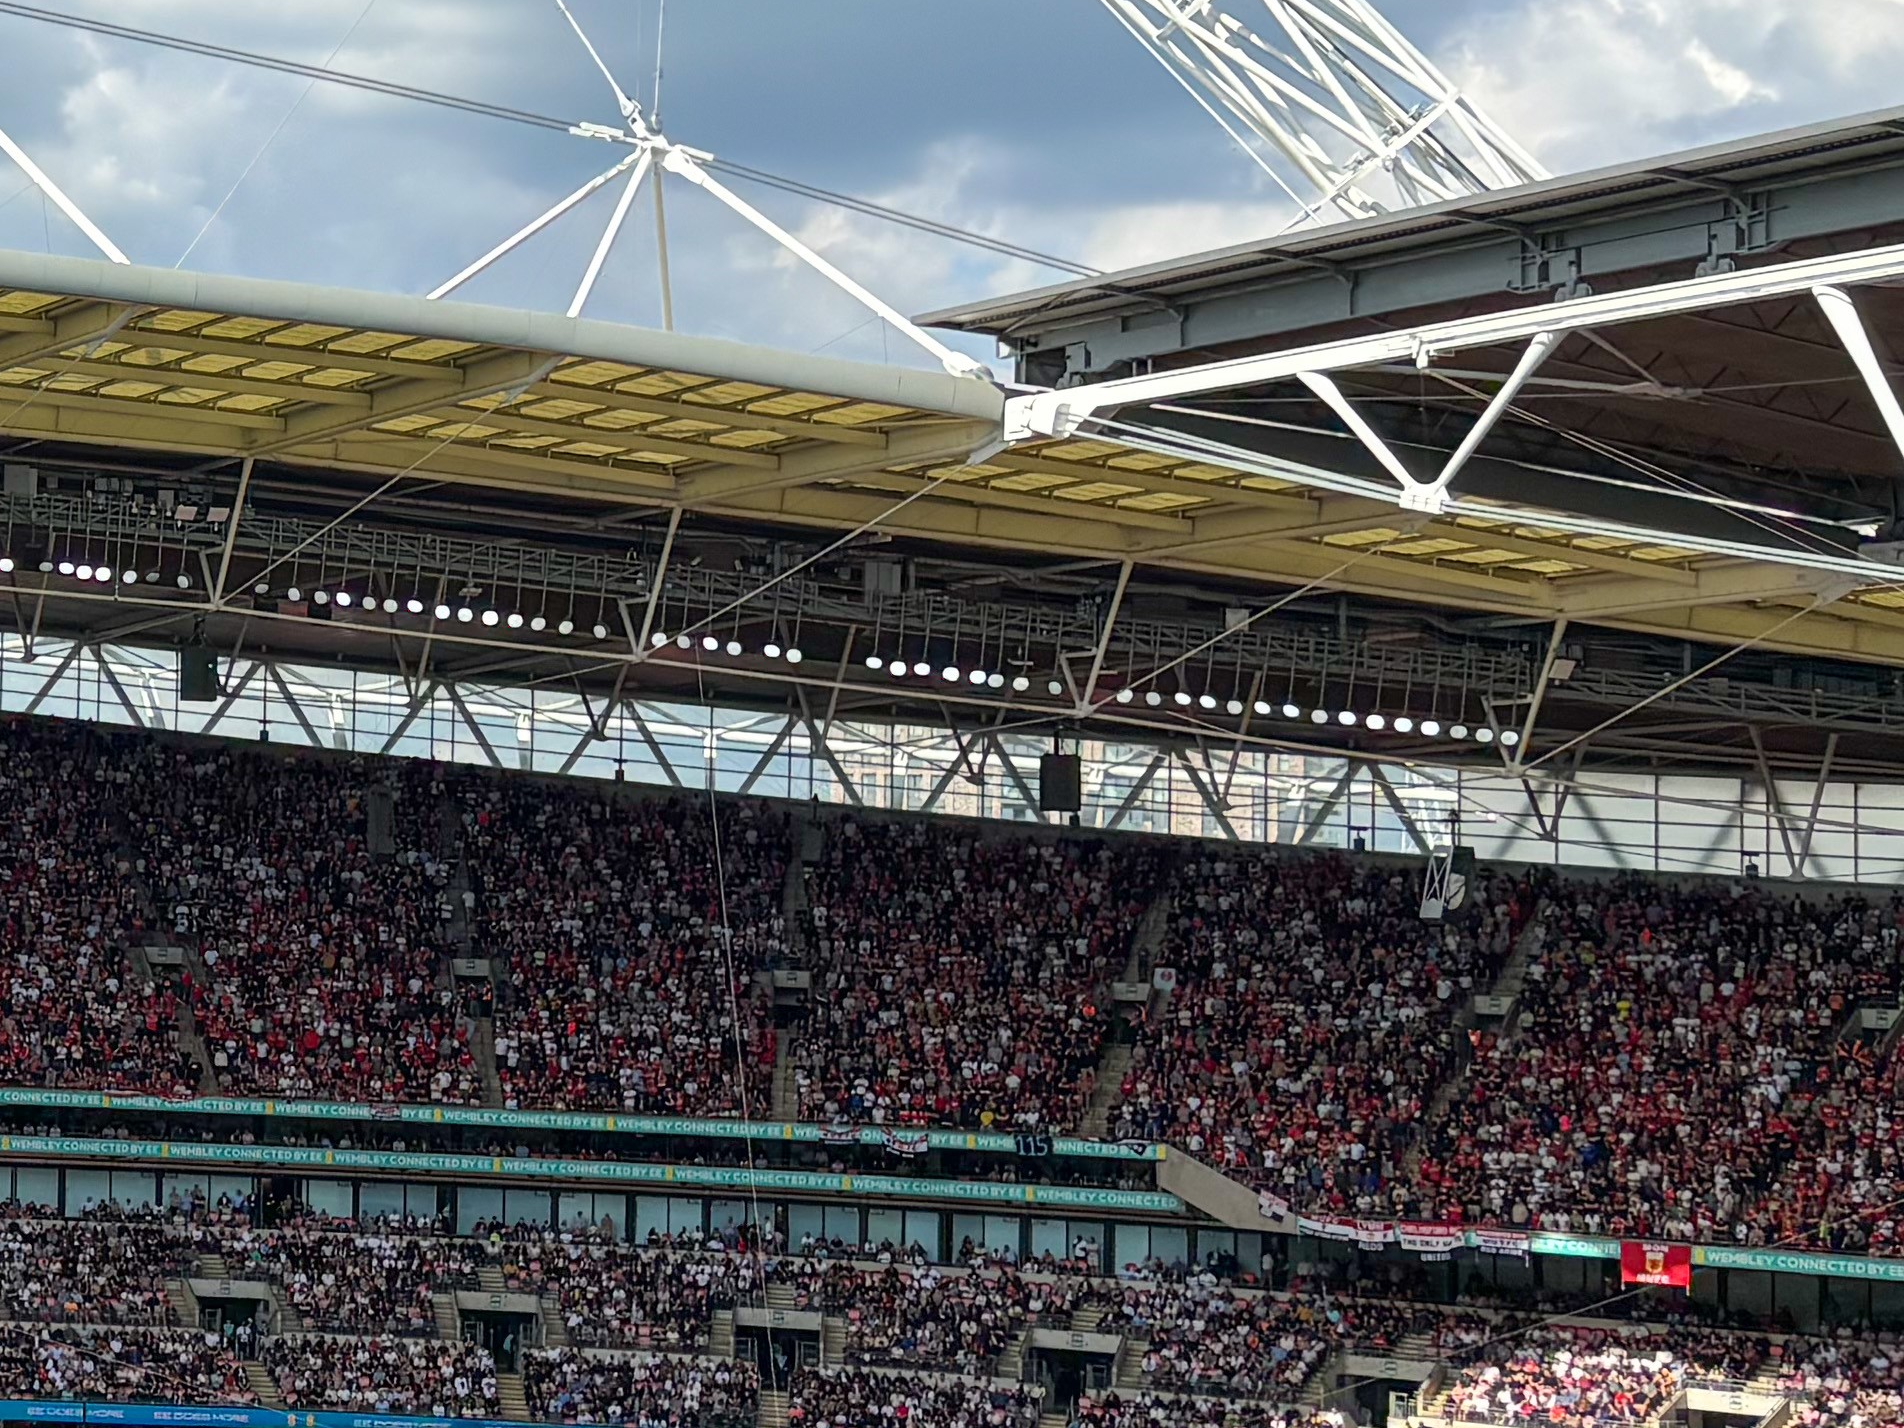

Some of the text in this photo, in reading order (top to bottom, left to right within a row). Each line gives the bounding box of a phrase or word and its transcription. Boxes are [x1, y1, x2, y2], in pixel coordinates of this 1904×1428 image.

[444, 1111, 498, 1122] WEMBLEY
[500, 1113, 571, 1126] CONNECTED
[170, 1146, 222, 1157] WEMBLEY
[224, 1148, 292, 1160] CONNECTED
[1016, 1135, 1048, 1156] 115
[1707, 1250, 1775, 1267] WEMBLEY
[1777, 1254, 1865, 1274] CONNECTED
[1867, 1263, 1889, 1276] BY
